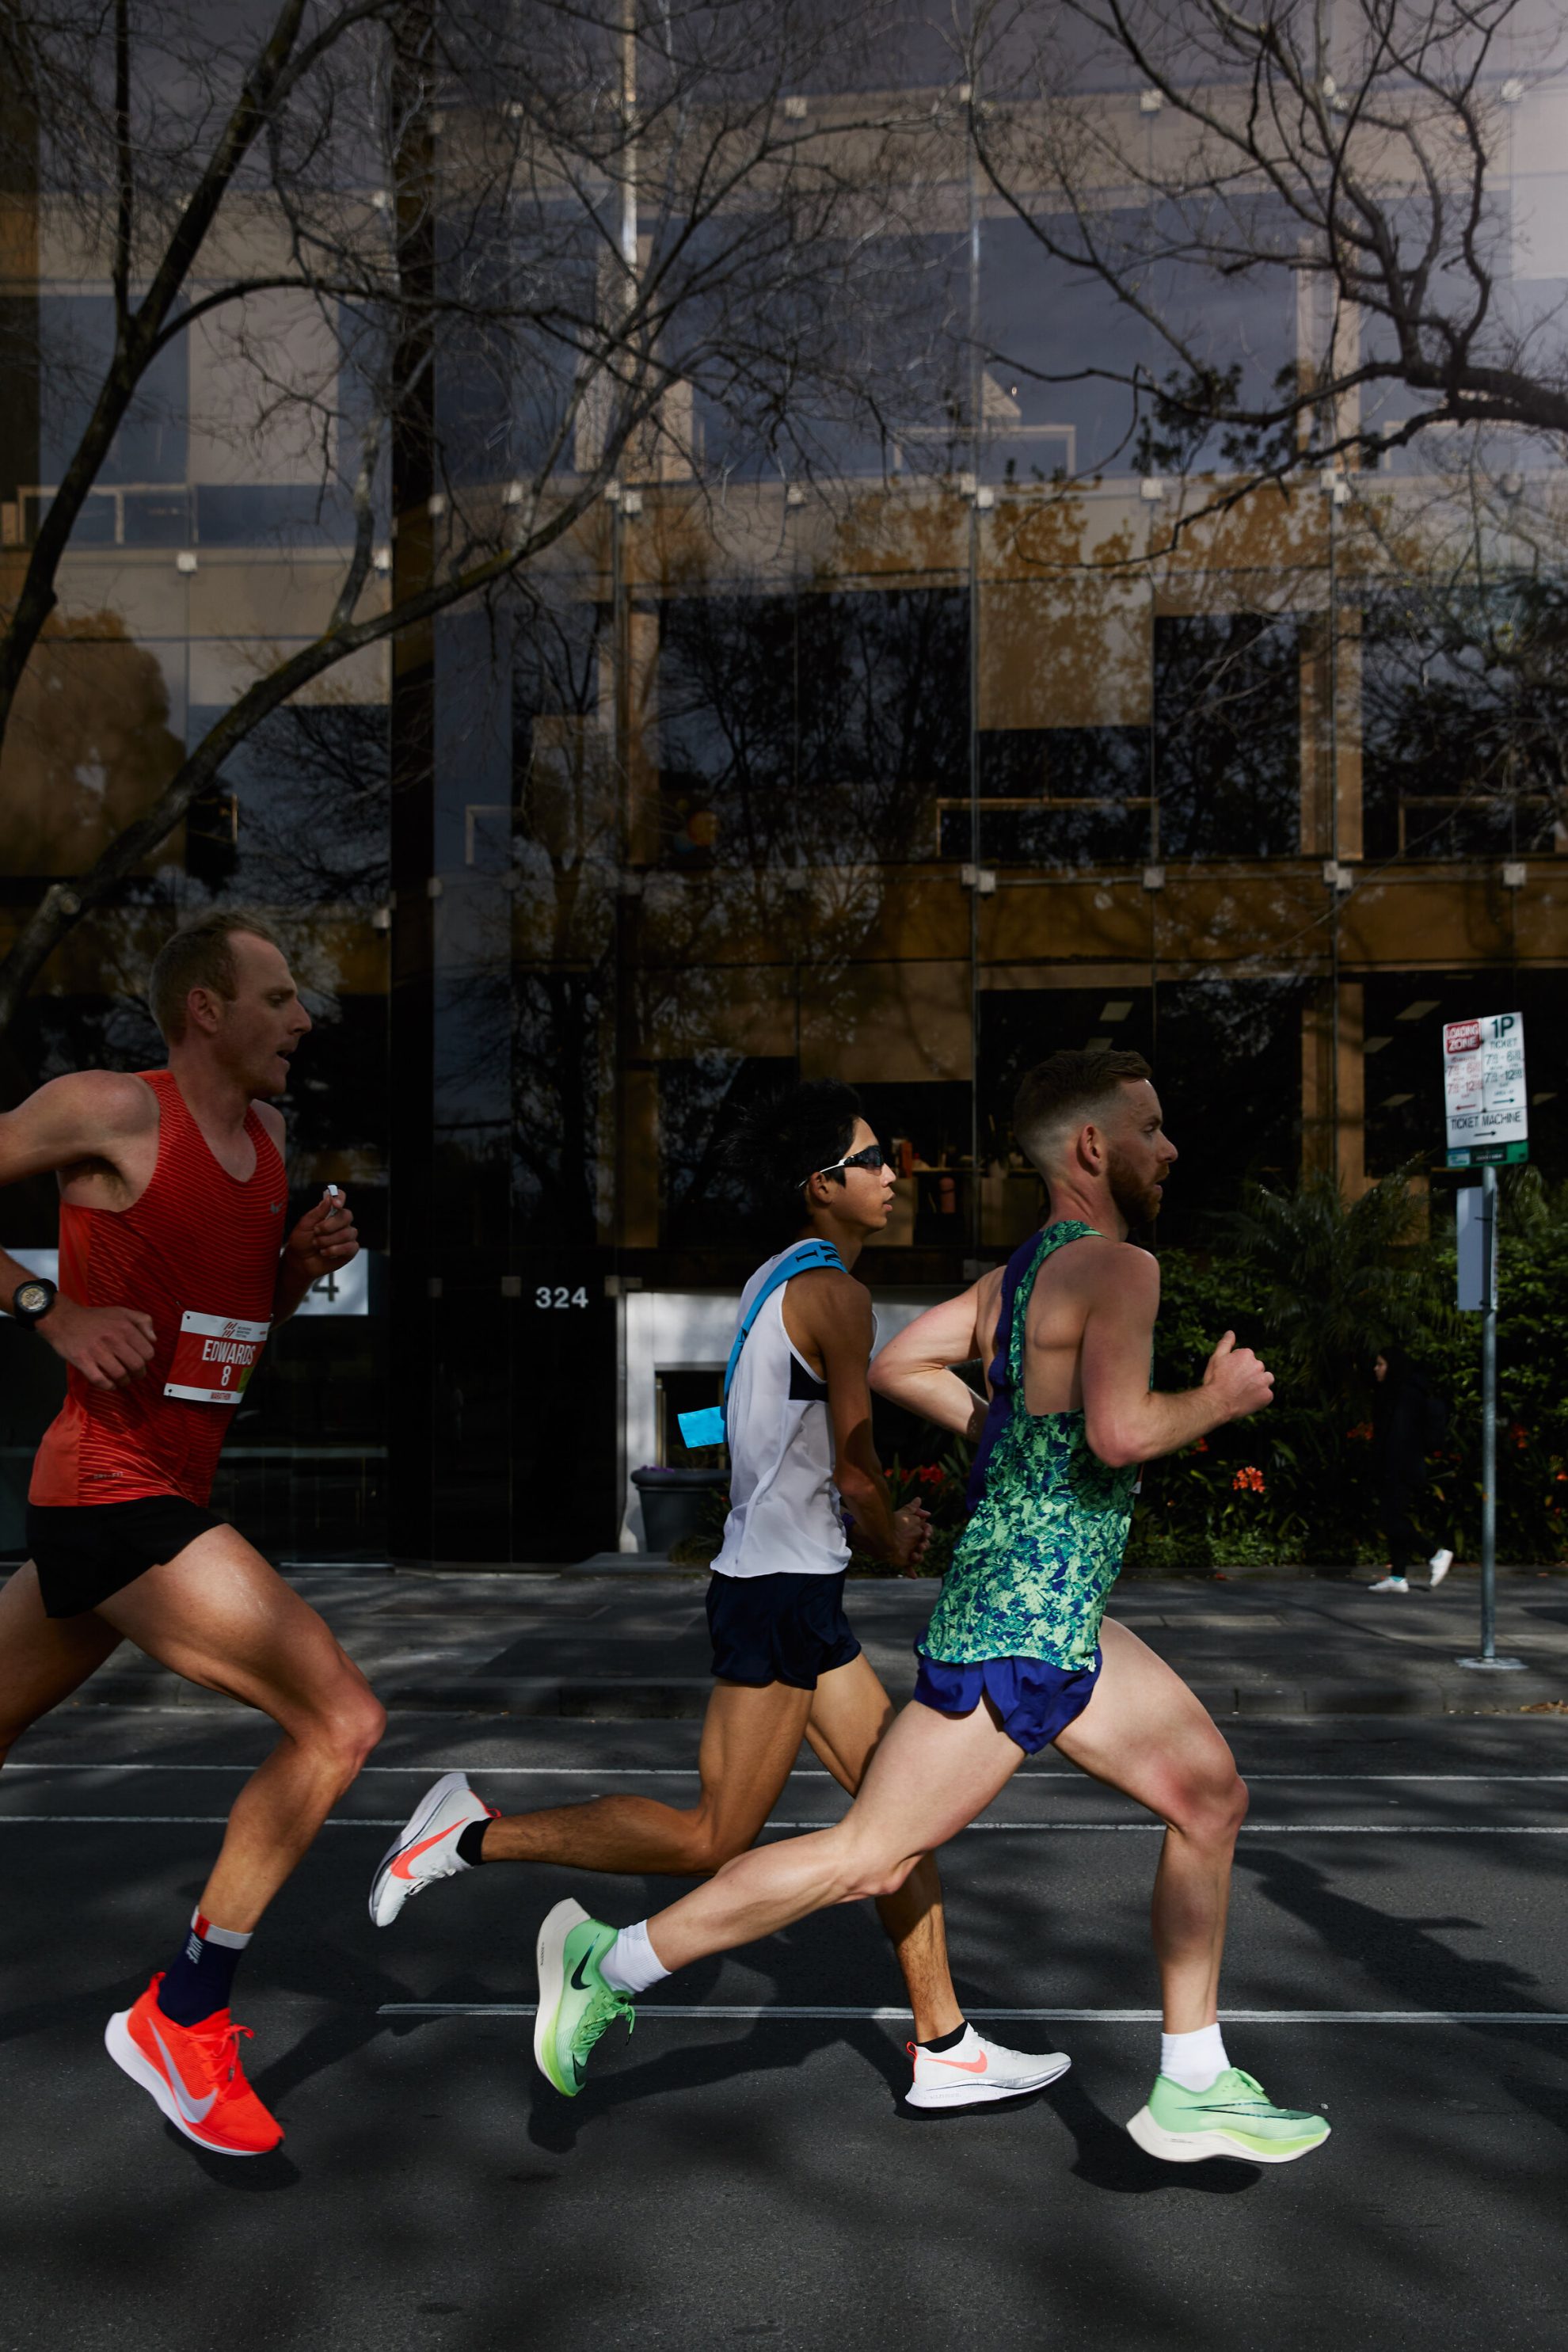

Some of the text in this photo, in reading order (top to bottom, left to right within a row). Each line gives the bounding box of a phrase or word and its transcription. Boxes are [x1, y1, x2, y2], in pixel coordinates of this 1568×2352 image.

[1446, 1024, 1479, 1038] LOADING
[1491, 1015, 1515, 1039] 1P
[1448, 1037, 1478, 1052] ZONE
[1490, 1038, 1519, 1050] TICKET
[1451, 1111, 1521, 1130] TICKET MACHINE
[535, 1286, 589, 1309] 324
[202, 1339, 257, 1365] EDWARDS
[221, 1365, 232, 1387] 8
